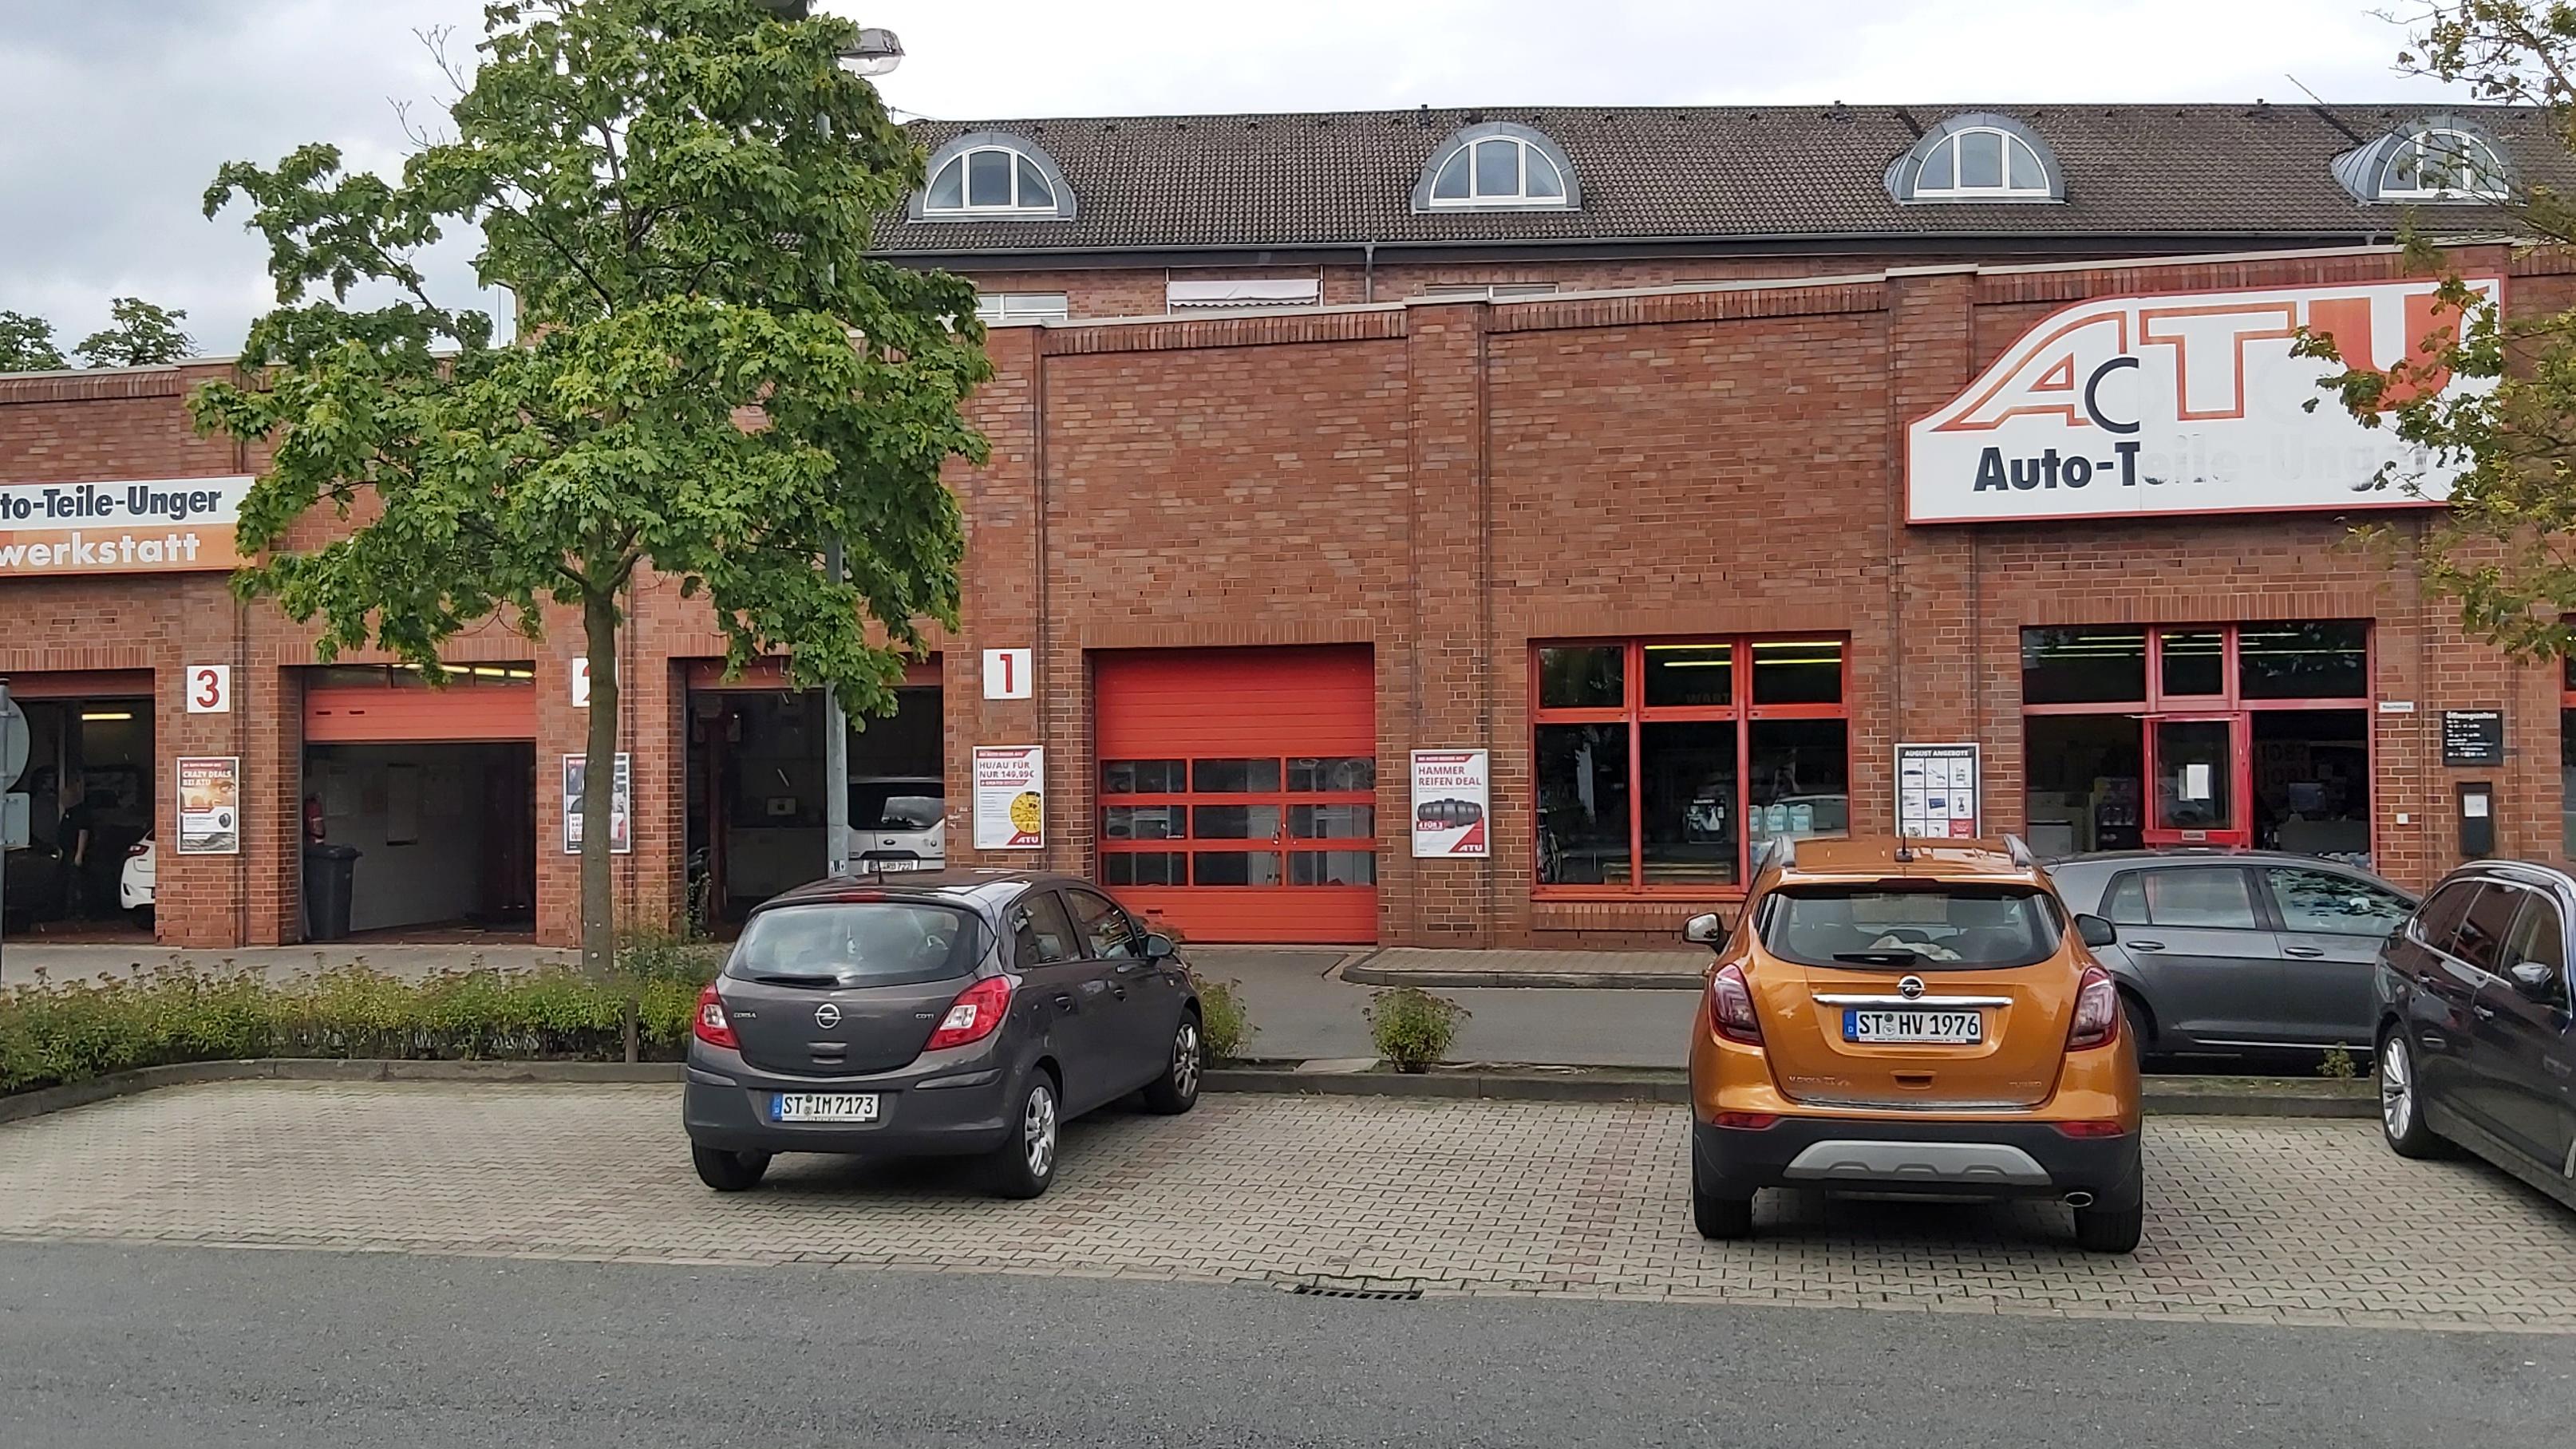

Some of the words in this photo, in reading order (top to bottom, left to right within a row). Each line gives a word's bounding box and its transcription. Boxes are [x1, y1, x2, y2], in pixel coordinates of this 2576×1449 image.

[1000, 654, 1013, 693] 1
[196, 669, 219, 708] 3
[1013, 760, 1030, 769] FÜR
[1418, 766, 1465, 775] HAMMER
[1418, 777, 1453, 786] REIFEN
[1456, 777, 1482, 786] DEAL
[1859, 1014, 1883, 1035] ST
[1899, 1015, 1924, 1035] HV
[1930, 1015, 1978, 1036] 1976
[784, 1097, 803, 1114] ST
[814, 1097, 832, 1114] IM
[836, 1097, 873, 1114] 7173
